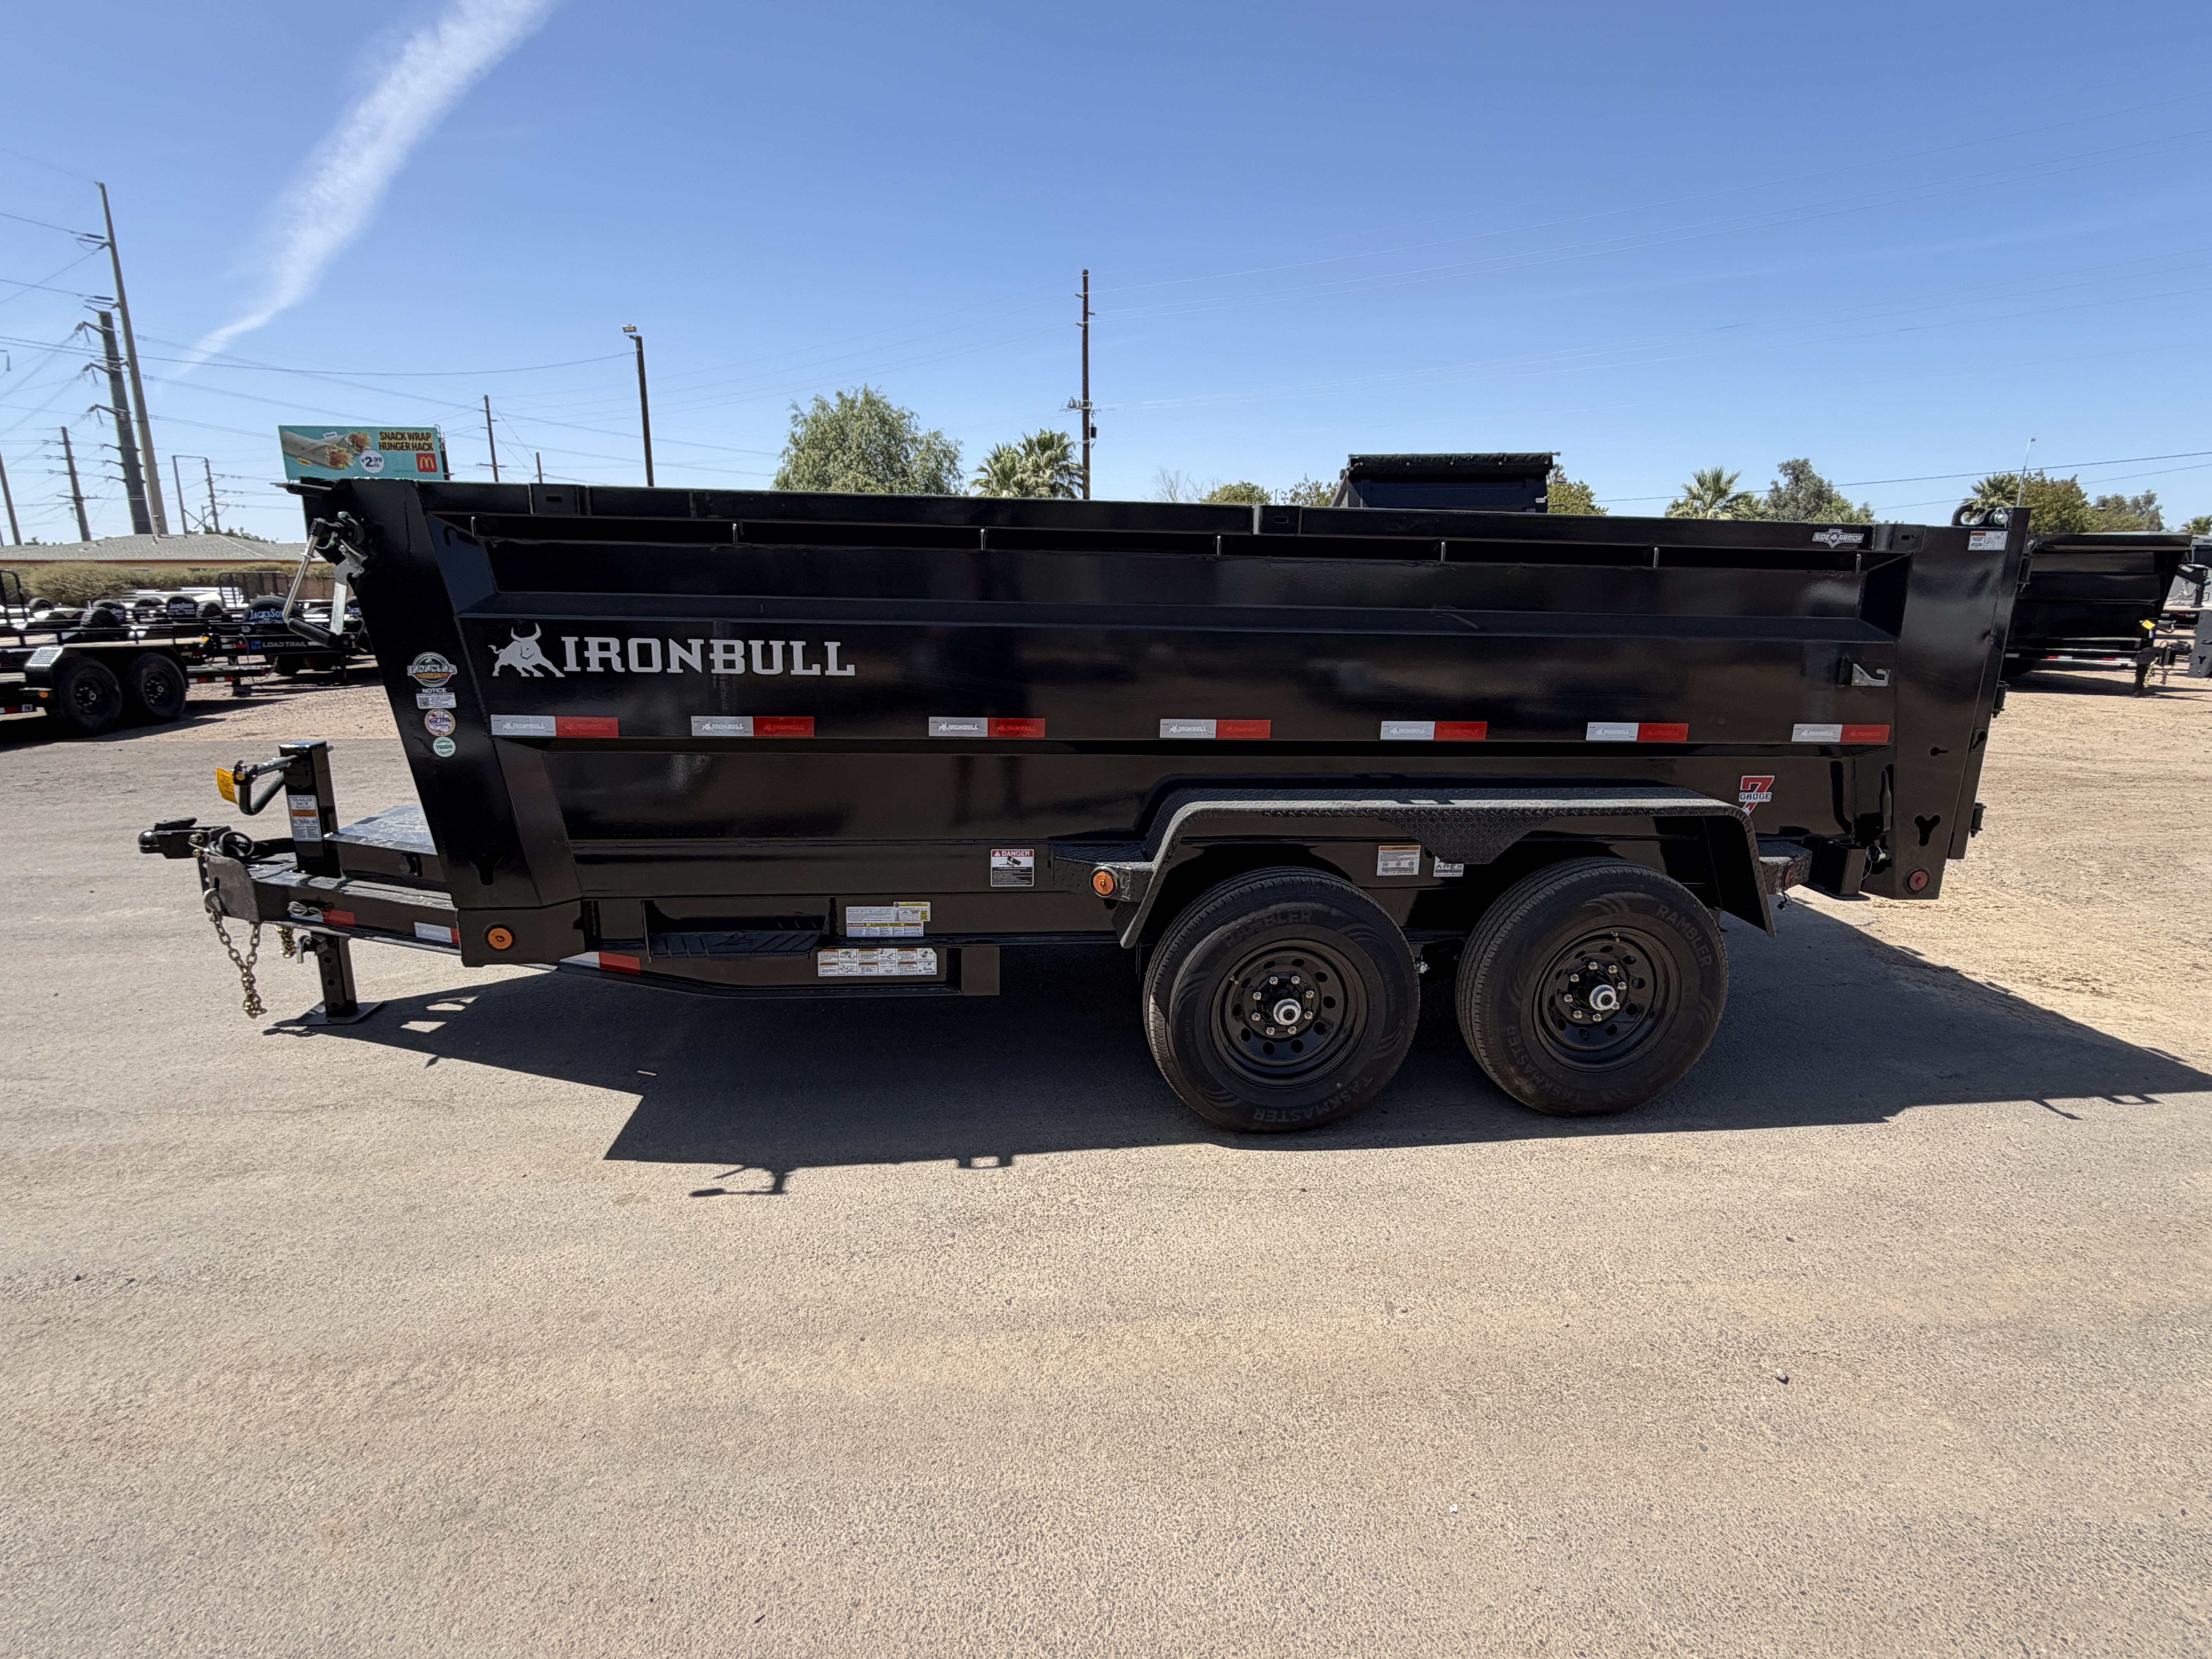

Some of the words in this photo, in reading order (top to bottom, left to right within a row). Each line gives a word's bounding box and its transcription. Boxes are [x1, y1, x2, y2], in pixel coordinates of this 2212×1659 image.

[379, 431, 406, 440] SNACK
[407, 432, 431, 441] WRAP
[379, 441, 411, 451] HUNGER
[412, 442, 434, 451] HACK
[561, 636, 855, 676] IRONBULL
[1740, 776, 1775, 816] 7
[1221, 908, 1313, 948] RAMBLER
[1656, 903, 1712, 967] RAMBLER
[1253, 1075, 1374, 1122] TASKMASTER
